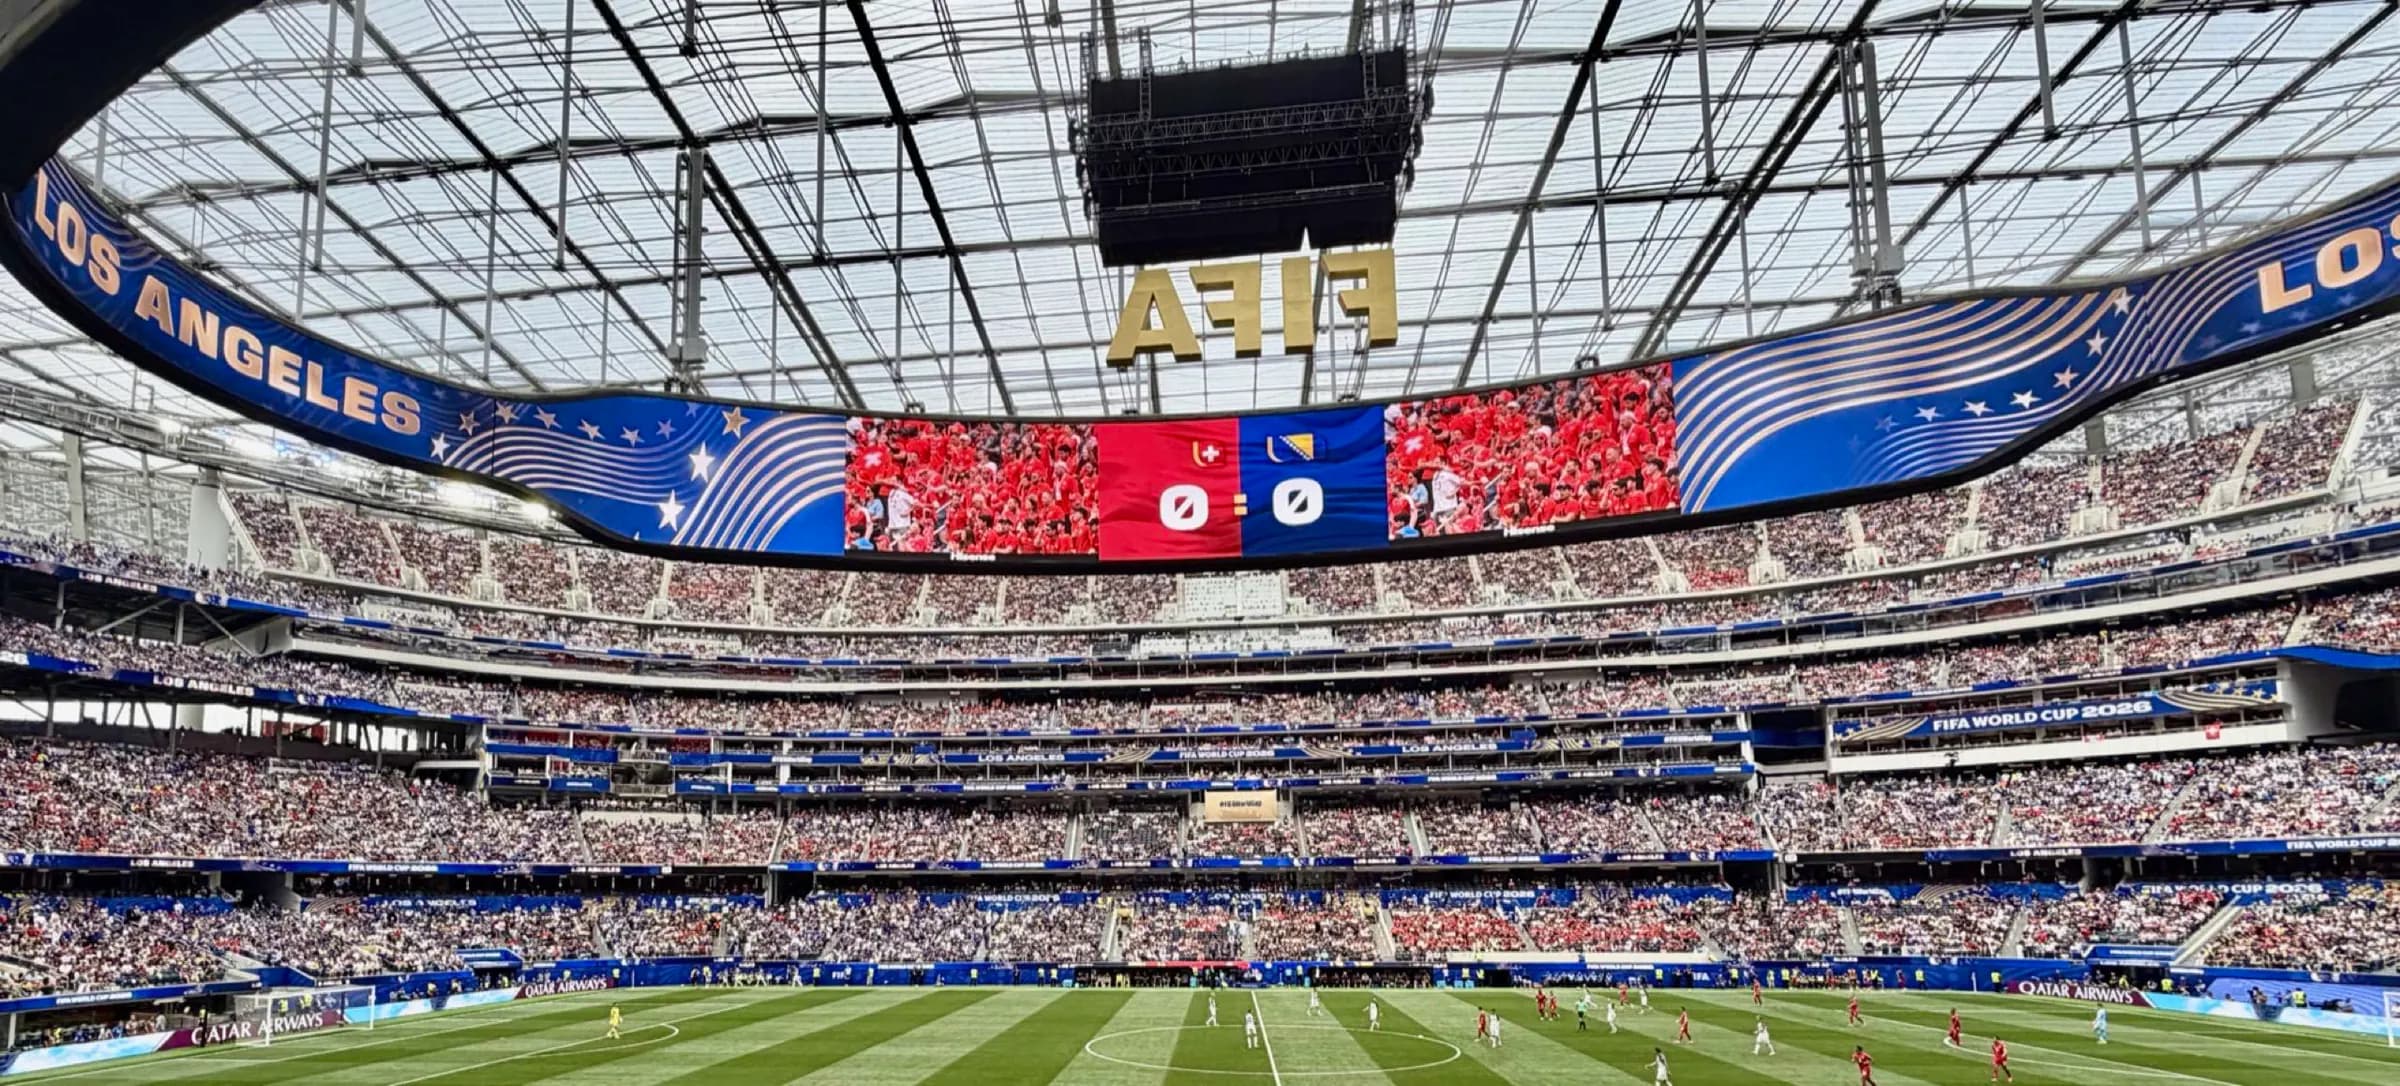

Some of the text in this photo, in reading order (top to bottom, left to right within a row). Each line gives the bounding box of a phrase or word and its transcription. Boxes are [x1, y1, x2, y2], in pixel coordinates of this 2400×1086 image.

[2258, 214, 2400, 314] LO
[34, 168, 422, 436] LOS ANGELES
[1160, 484, 1209, 531] 0
[1273, 477, 1325, 527] 0
[153, 674, 255, 697] LOS ANGELES
[1932, 700, 2153, 732] FIFA WORLD CUP 2026
[978, 754, 1065, 762] LOS ANGELES
[1180, 751, 1198, 759] FIFA
[1198, 751, 1228, 759] WORLD
[1403, 743, 1498, 752] LOS ANGELES
[2286, 840, 2314, 849] FIFA
[2314, 840, 2360, 848] WORLD
[2361, 839, 2386, 847] CUP
[2231, 884, 2263, 894] CUP
[525, 978, 607, 998] QATAR AIRWAYS
[2018, 981, 2134, 1004] QATAR AIRWAYS
